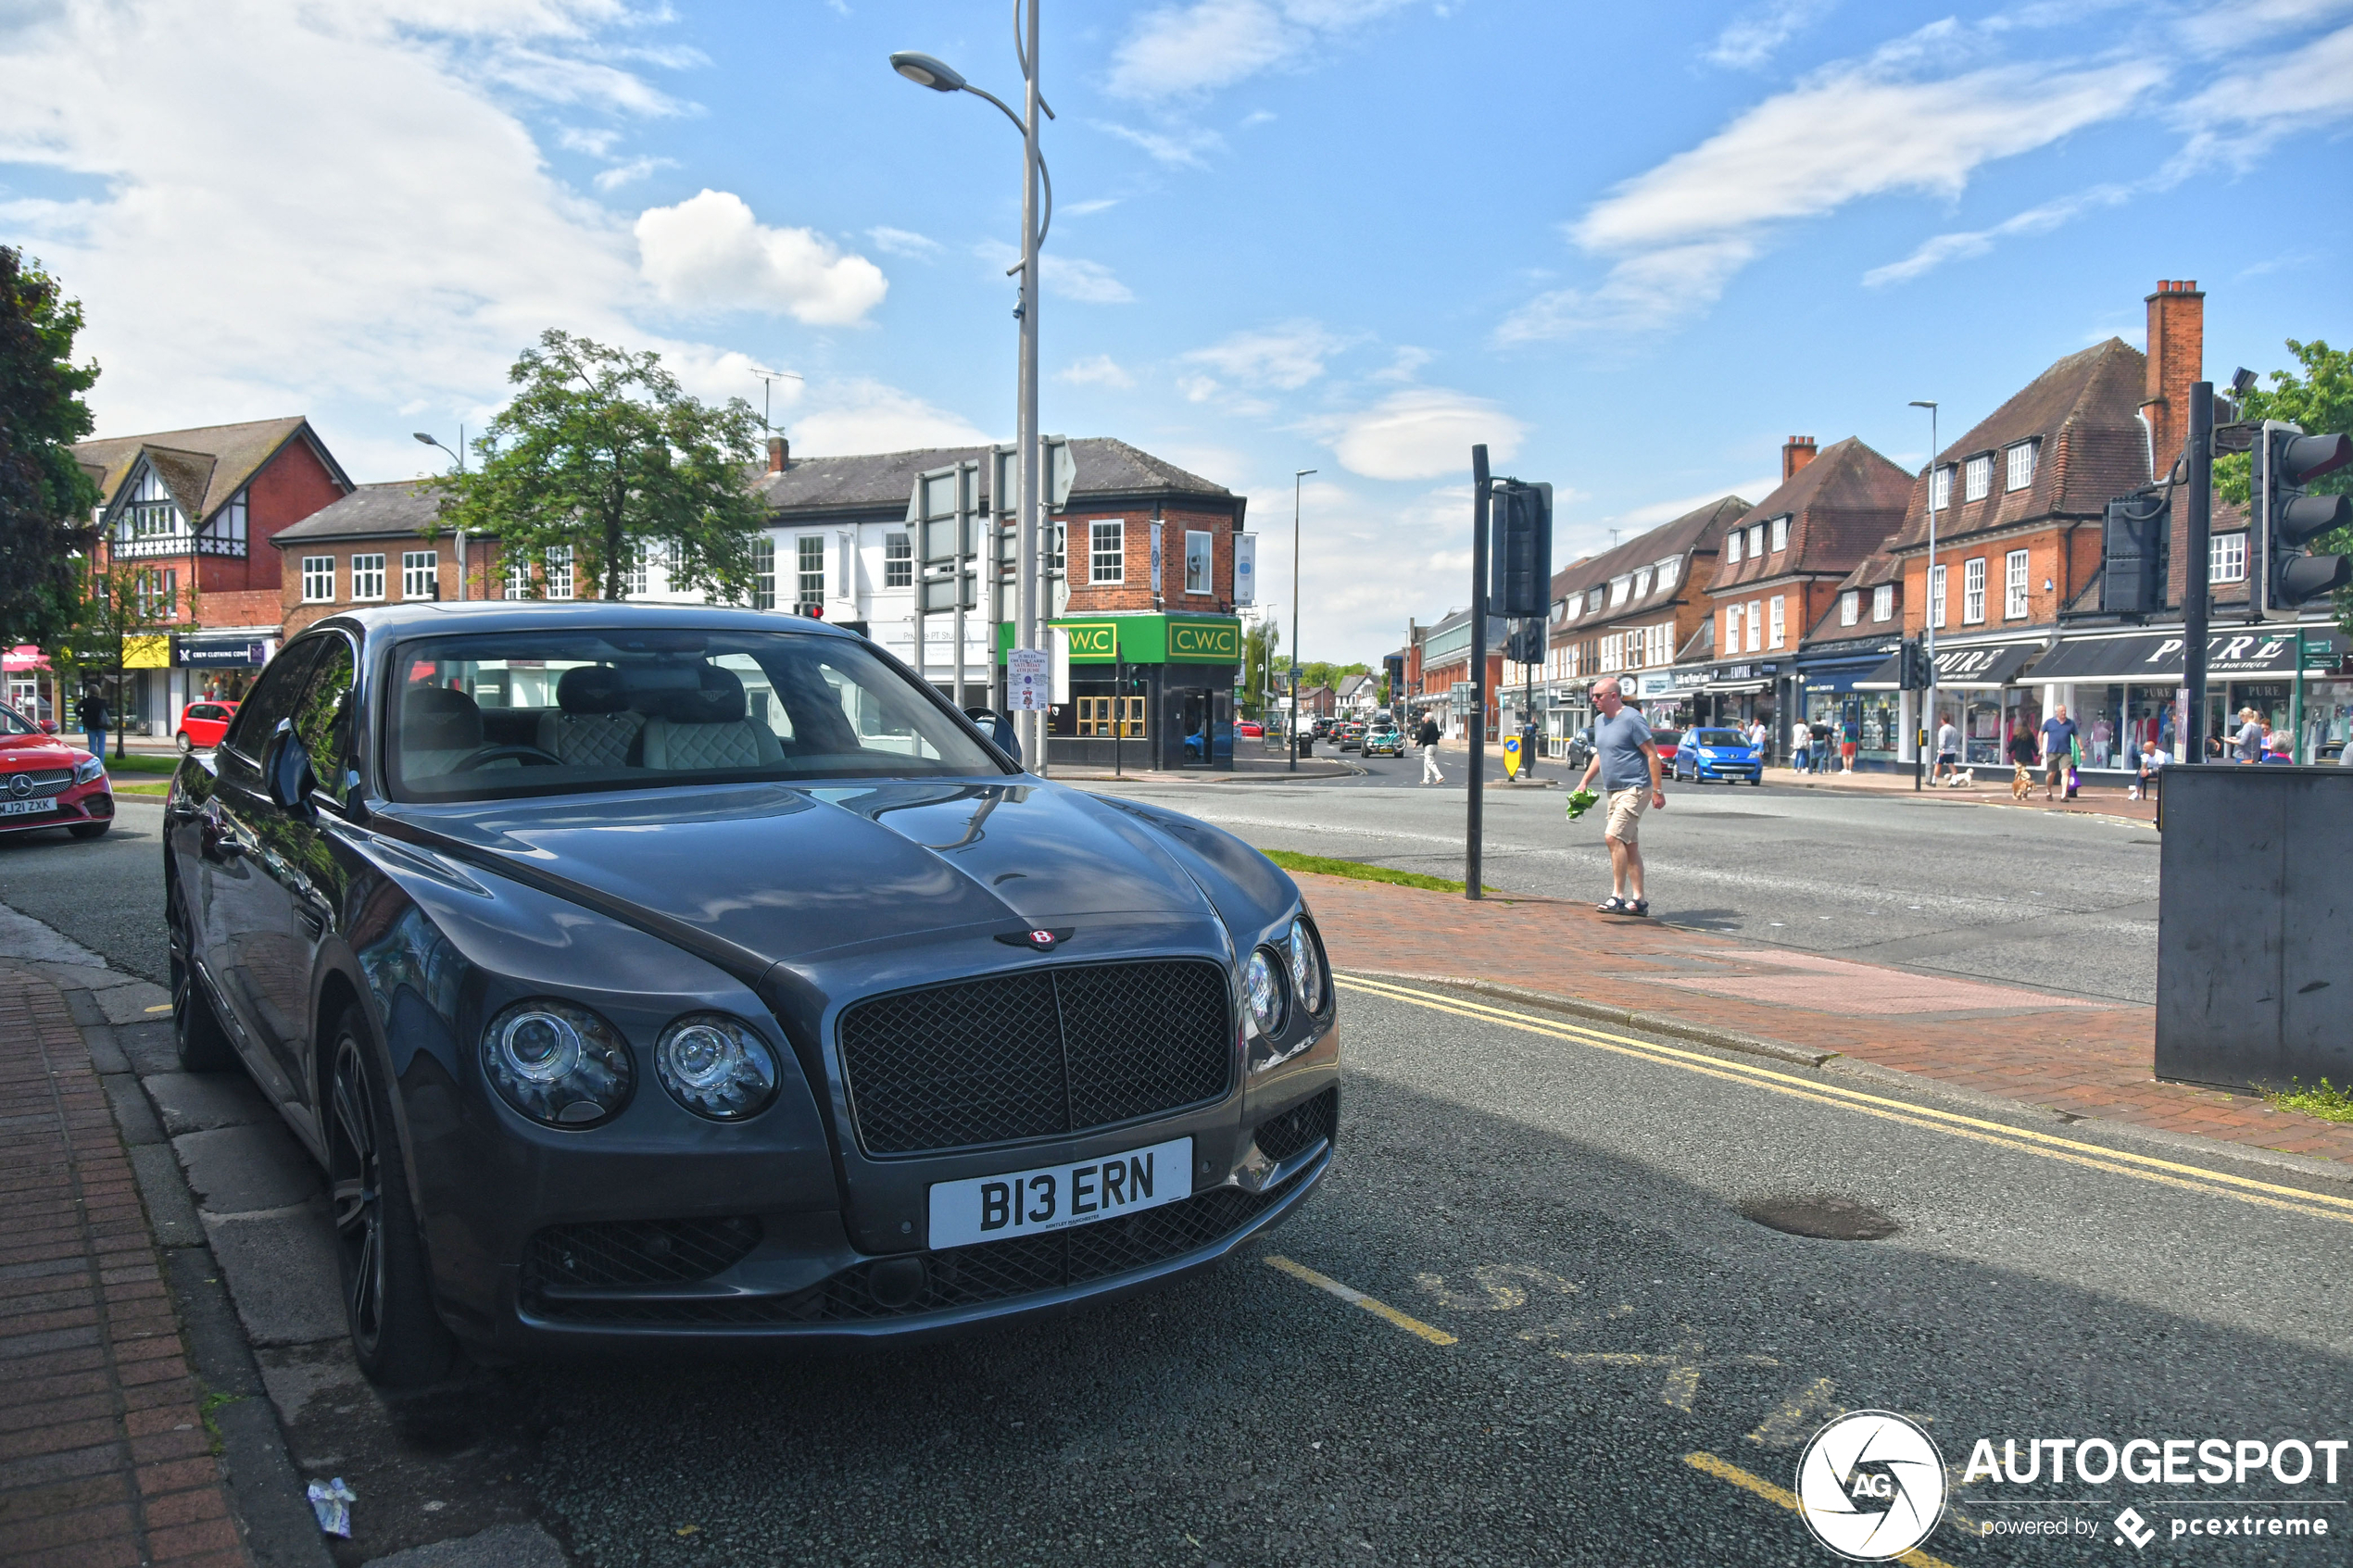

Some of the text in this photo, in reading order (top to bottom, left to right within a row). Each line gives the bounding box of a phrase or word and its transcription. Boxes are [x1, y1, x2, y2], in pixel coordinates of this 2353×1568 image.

[1176, 630, 1231, 651] C.W.C
[208, 650, 233, 659] CLOTHING
[1933, 649, 2005, 672] PURE
[1730, 664, 1751, 679] EMPIRE
[2248, 685, 2281, 696] PURE
[28, 799, 50, 811] ZXK
[1071, 1152, 1154, 1216] ERN
[1045, 1213, 1101, 1229] BENTLEY MANCHESTER
